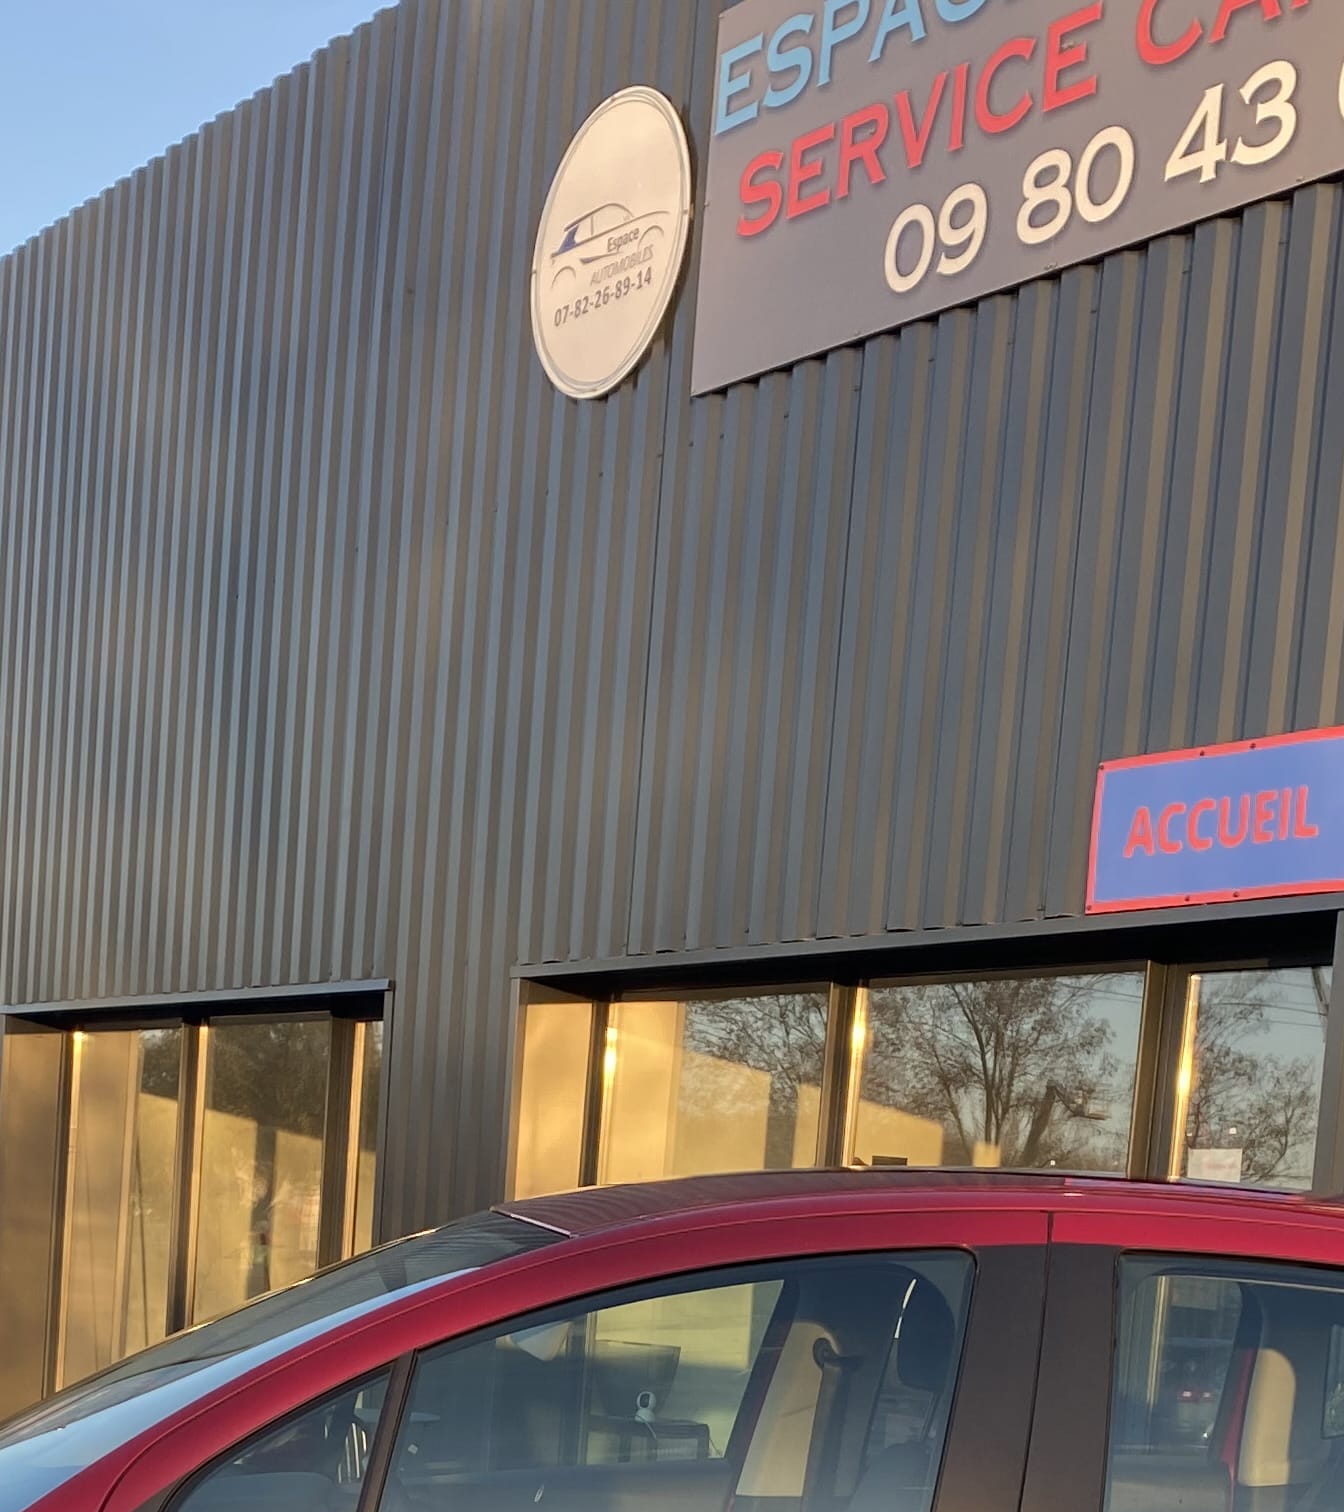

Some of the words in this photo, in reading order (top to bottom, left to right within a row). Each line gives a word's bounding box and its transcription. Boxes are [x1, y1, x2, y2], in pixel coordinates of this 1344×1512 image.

[714, 0, 986, 136] ESPA
[736, 0, 1104, 238] SERVICE
[884, 182, 988, 293] 09
[1016, 125, 1135, 245] 80
[1164, 60, 1297, 184] 43
[607, 228, 640, 253] Espace
[553, 265, 653, 328] 07-82-26-89-14
[1122, 784, 1320, 859] ACCUEIL
